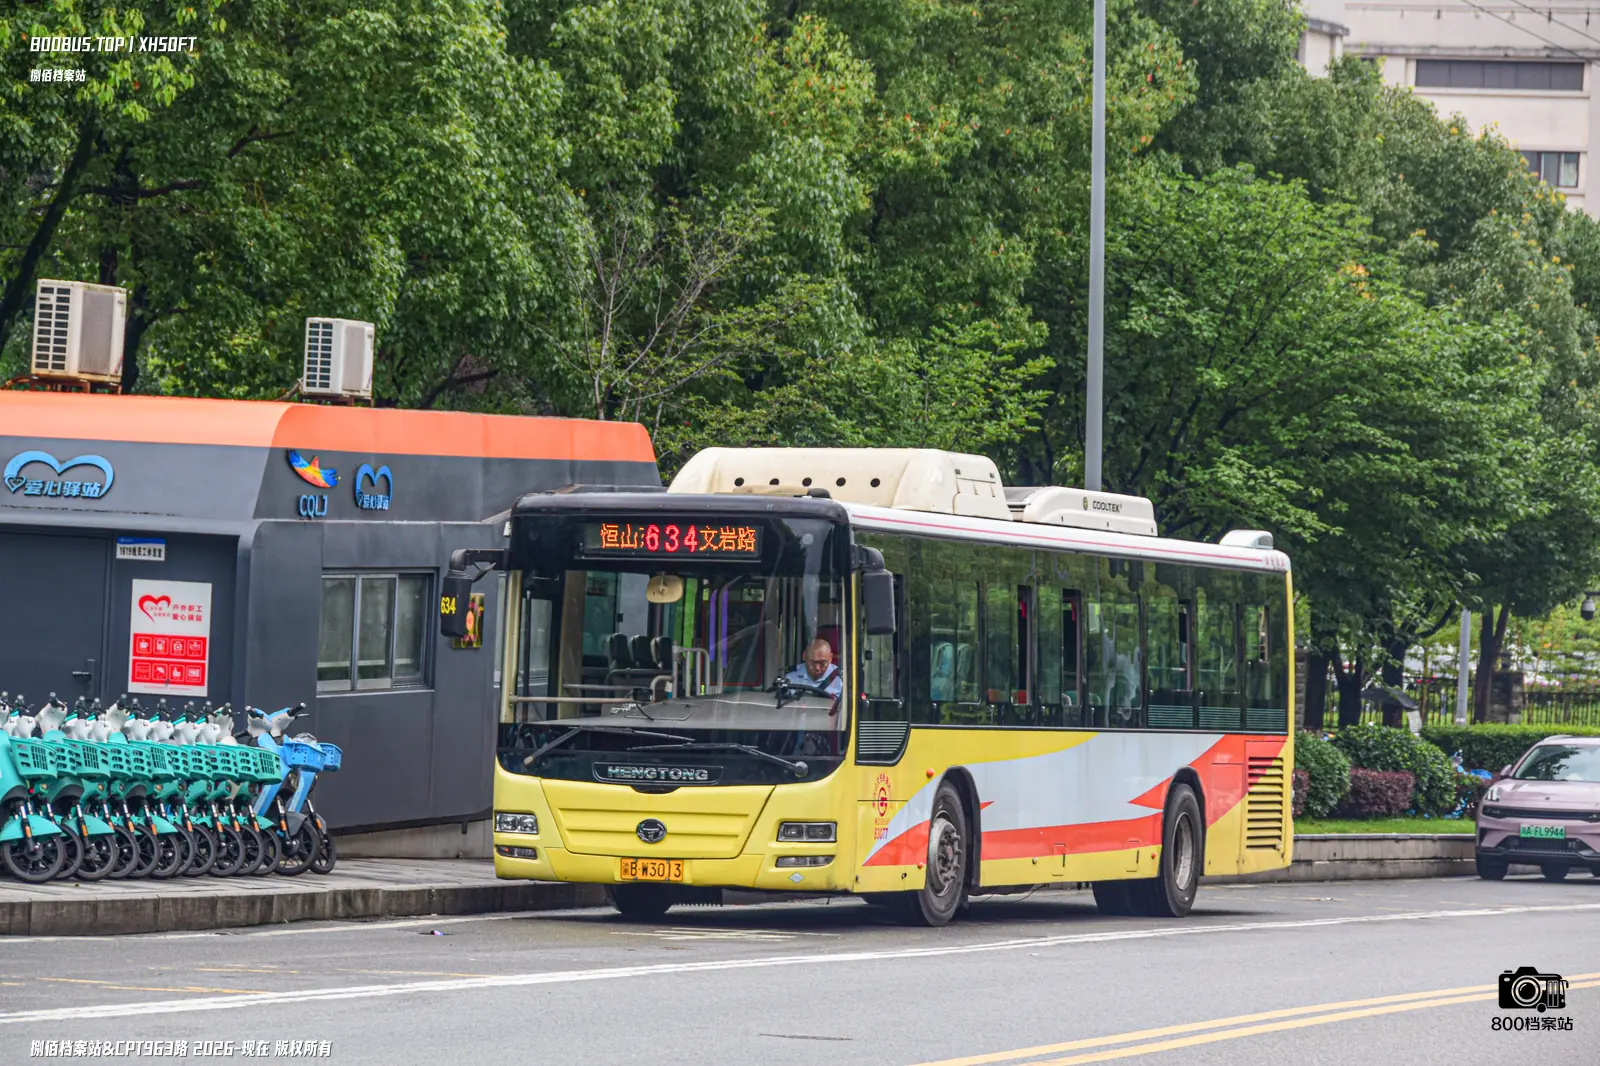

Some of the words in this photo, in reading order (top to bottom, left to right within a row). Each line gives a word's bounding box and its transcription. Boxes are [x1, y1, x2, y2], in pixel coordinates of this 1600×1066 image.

[24, 480, 101, 498] 爱心驿站
[299, 494, 328, 518] CQLJ
[1092, 500, 1121, 513] COOLTEK
[645, 524, 698, 552] 634
[440, 596, 457, 615] 634
[607, 765, 709, 781] HENGTONG
